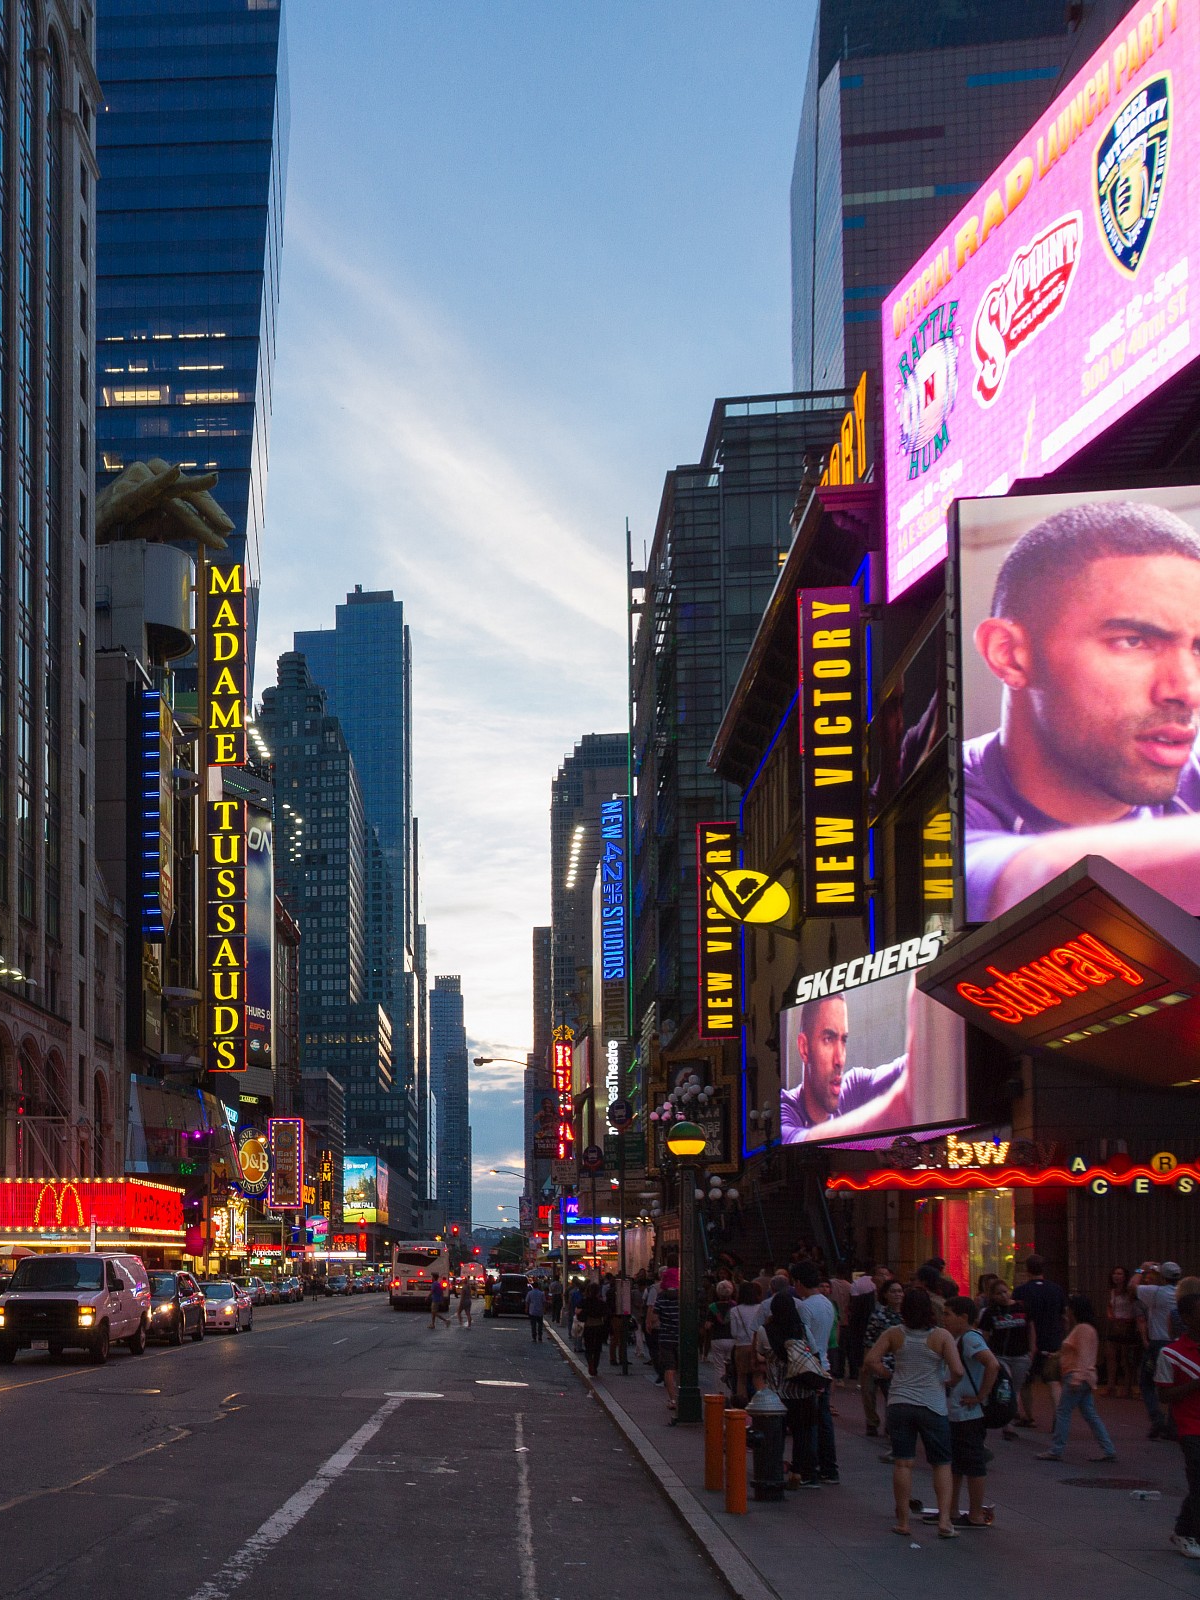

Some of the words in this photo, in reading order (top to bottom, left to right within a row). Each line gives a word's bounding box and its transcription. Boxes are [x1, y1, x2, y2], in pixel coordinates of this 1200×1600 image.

[892, 246, 953, 338] OFFICIAL
[955, 157, 1034, 271] RAD
[1037, 61, 1110, 181] LAUNCH
[1113, 0, 1179, 95] PARTY
[898, 300, 960, 388] RATTLE
[908, 418, 951, 482] HUM
[208, 563, 243, 765] MADAME
[811, 599, 854, 788] VICTORY
[601, 799, 623, 839] NEW
[815, 816, 855, 905] NEW
[211, 801, 241, 1071] TUSSAUD'S
[603, 905, 624, 980] STUDIOS
[795, 930, 944, 1006] SKECHERS
[707, 971, 733, 1030] NEW
[955, 931, 1146, 1026] Subway
[239, 1151, 269, 1172] D&B
[322, 1162, 331, 1220] EMRE
[1071, 1157, 1087, 1172] A
[1159, 1156, 1172, 1170] R
[1092, 1179, 1108, 1194] C
[1135, 1178, 1150, 1193] E
[1178, 1178, 1194, 1193] S
